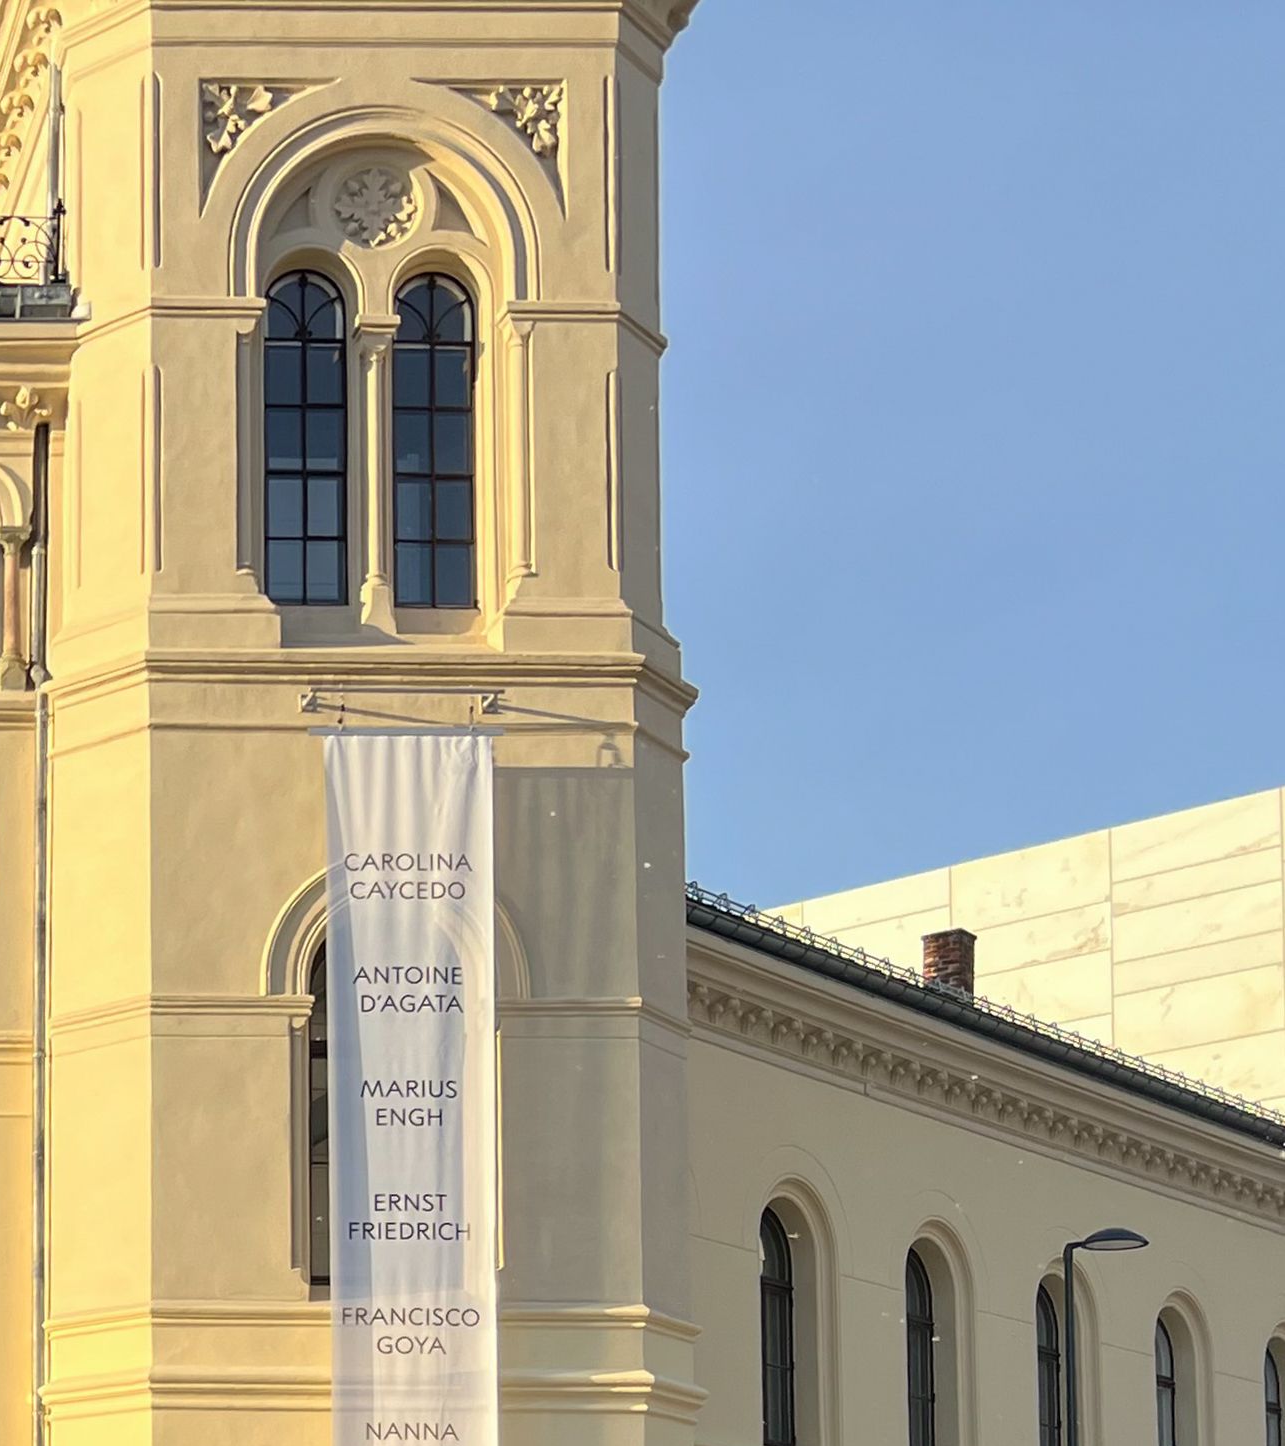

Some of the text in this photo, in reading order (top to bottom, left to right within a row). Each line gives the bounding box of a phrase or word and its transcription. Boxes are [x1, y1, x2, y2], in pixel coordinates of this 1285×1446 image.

[344, 853, 473, 872] CAROLINA
[350, 881, 466, 900] CAYCEDO
[352, 966, 463, 985] ANTOINE
[360, 994, 464, 1013] D'AGATA
[360, 1080, 458, 1099] MARIUS
[375, 1108, 443, 1127] ENGH
[374, 1194, 448, 1212] ERNST
[348, 1222, 471, 1241] FRIEDRICH
[342, 1307, 480, 1327] FRANCISCO
[376, 1336, 447, 1355] GOYA
[365, 1422, 460, 1441] NANNA
